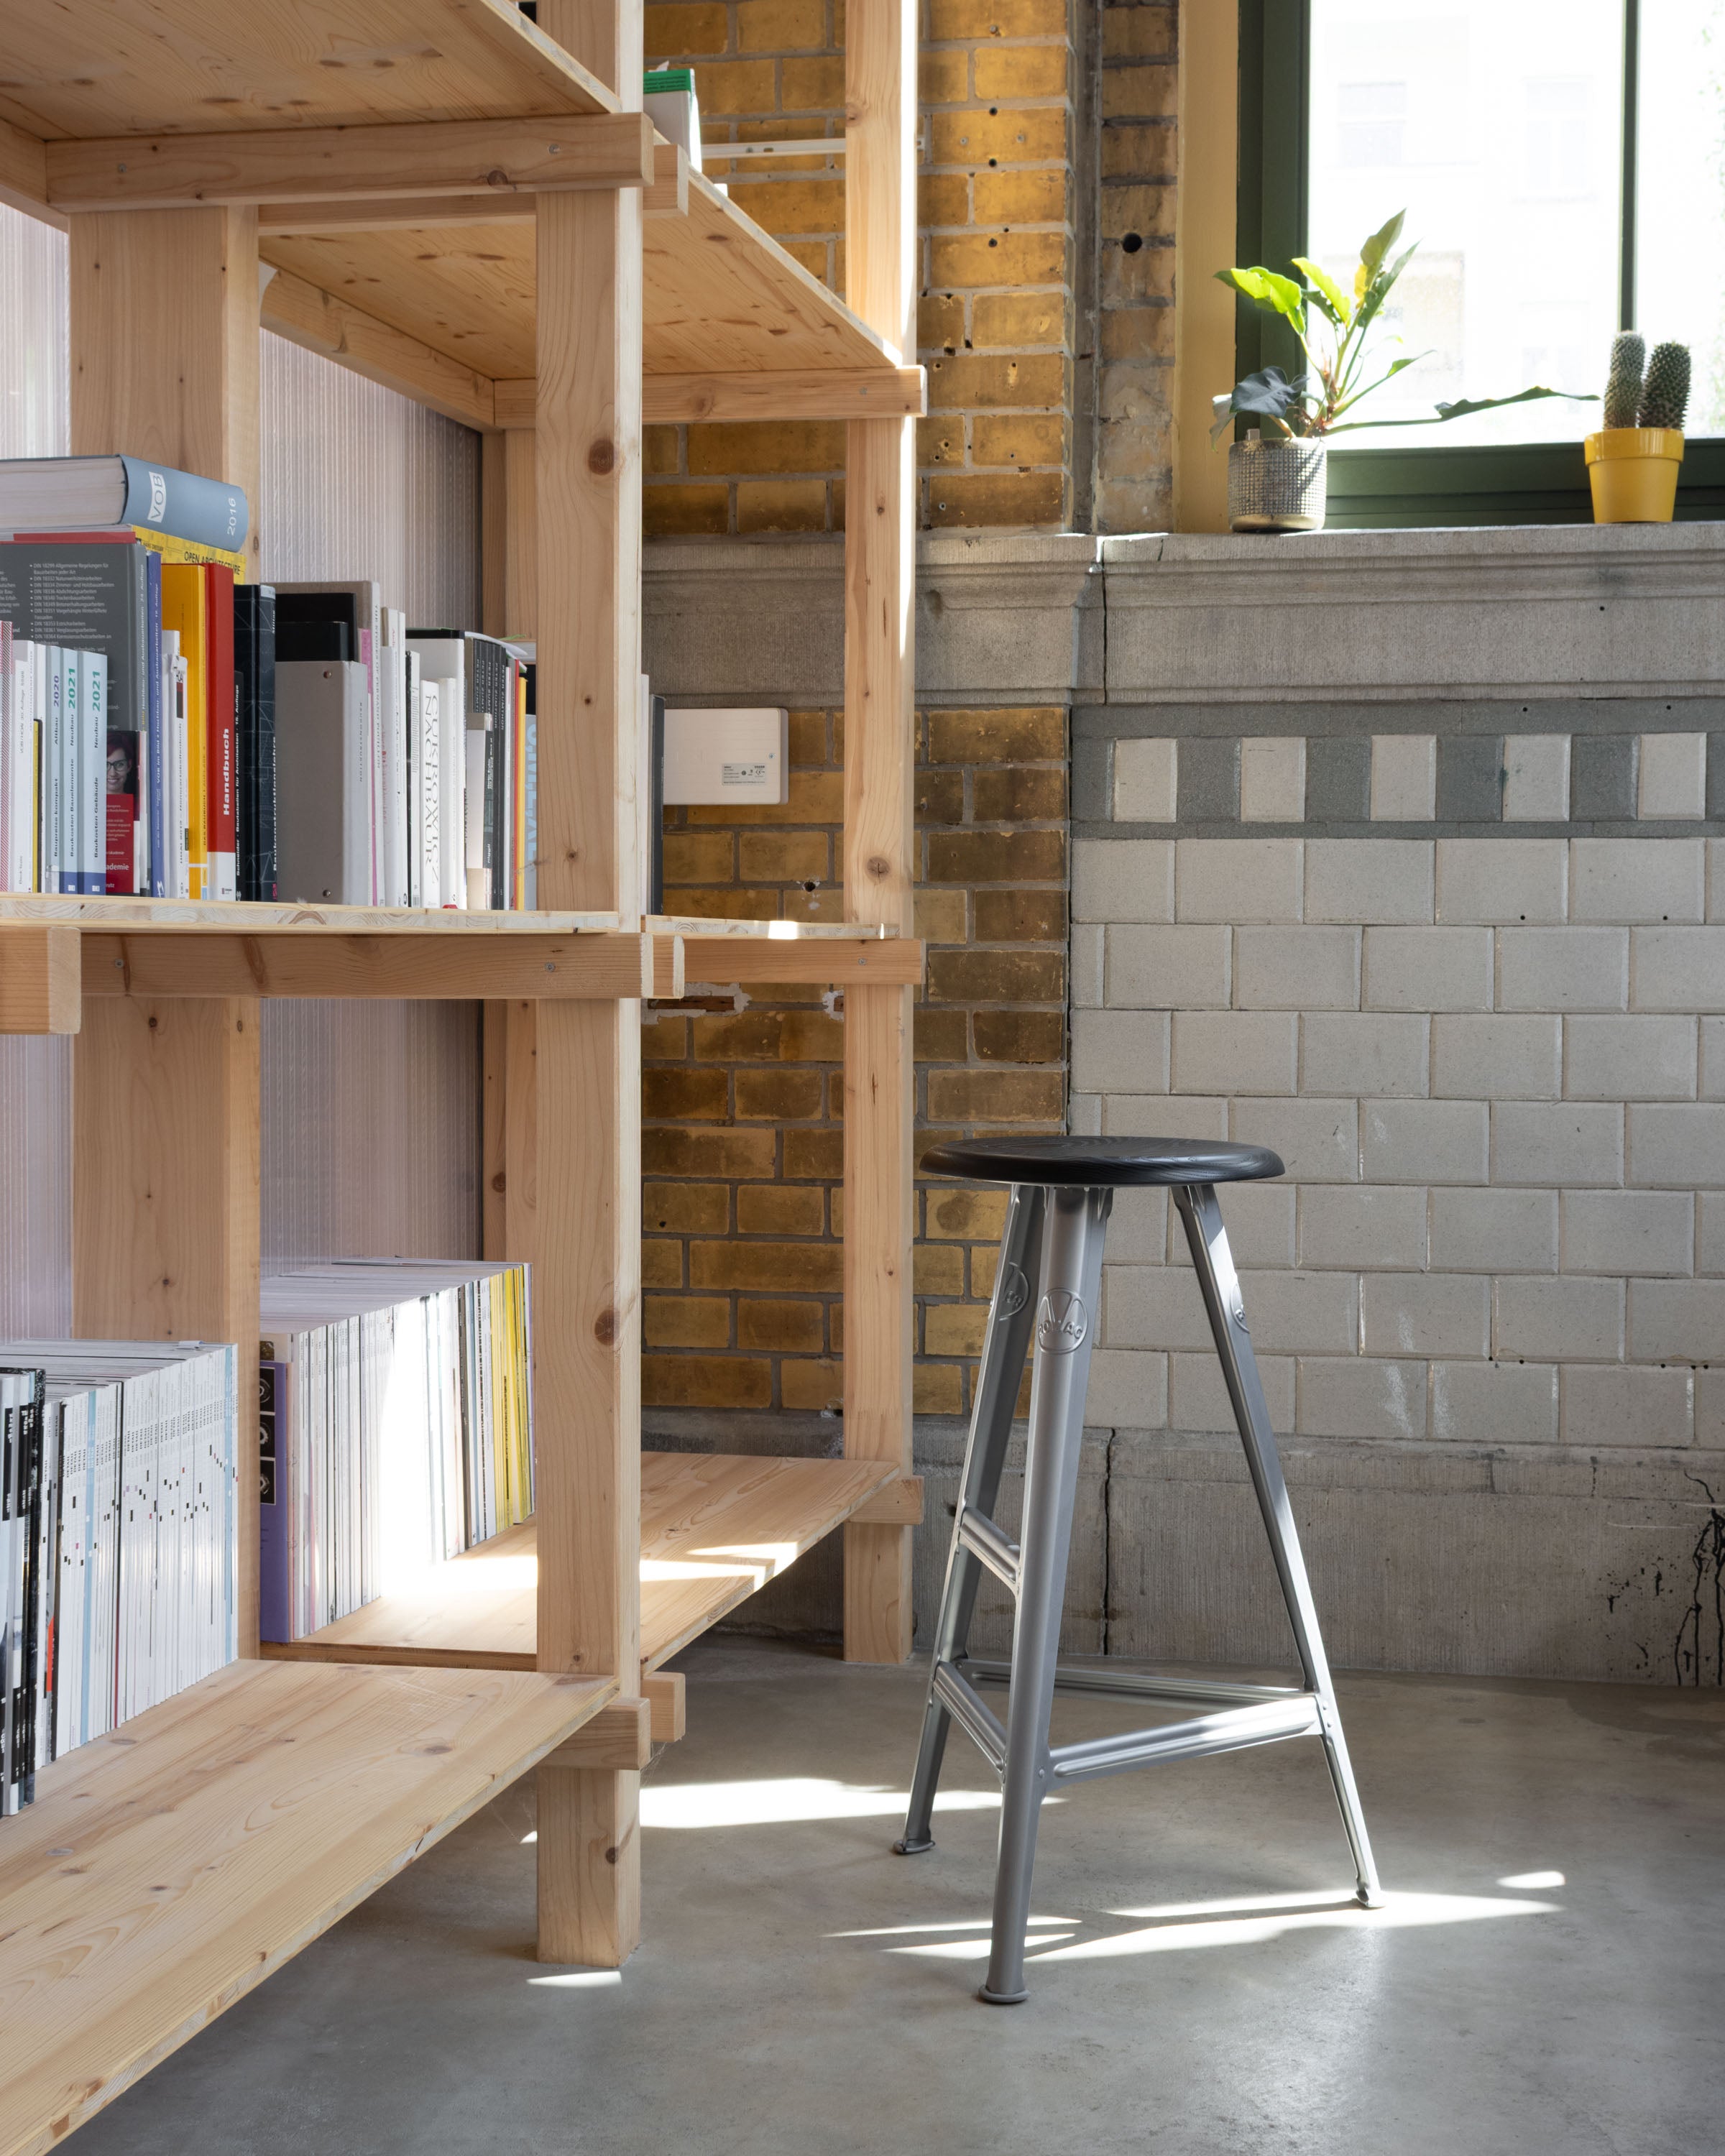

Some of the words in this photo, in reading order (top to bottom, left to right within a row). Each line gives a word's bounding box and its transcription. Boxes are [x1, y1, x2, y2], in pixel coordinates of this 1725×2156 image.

[151, 475, 162, 520] VOB
[226, 497, 236, 537] 2016
[184, 551, 200, 563] OPEN
[92, 671, 101, 712] 2021
